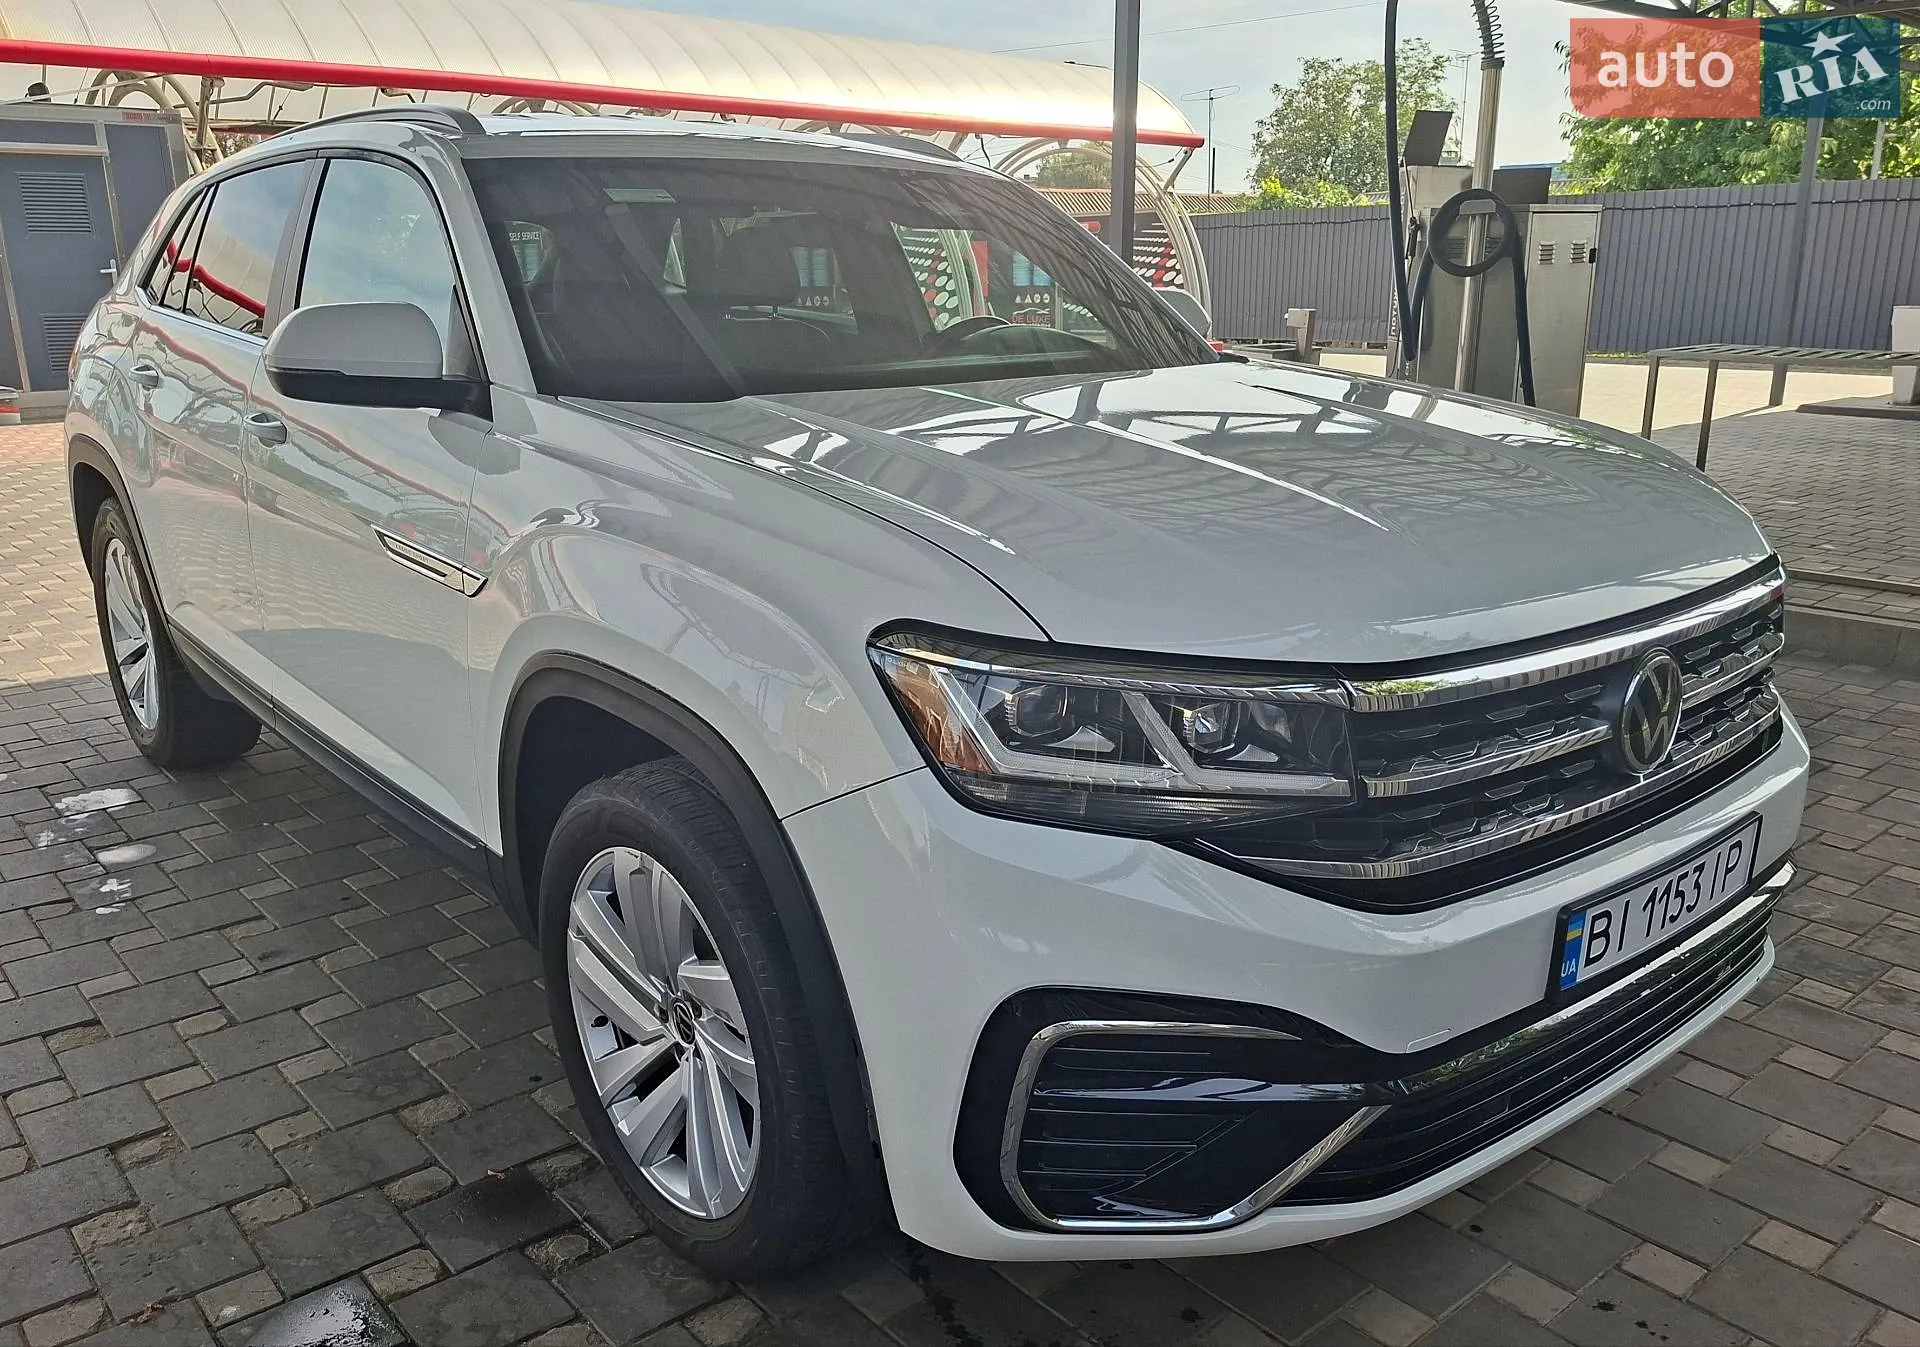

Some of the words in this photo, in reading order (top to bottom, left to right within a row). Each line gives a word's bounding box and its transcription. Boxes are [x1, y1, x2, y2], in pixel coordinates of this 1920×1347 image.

[1584, 900, 1630, 968] BI
[1642, 862, 1706, 938] 1153
[1709, 839, 1743, 900] IP
[1561, 960, 1577, 977] UA
